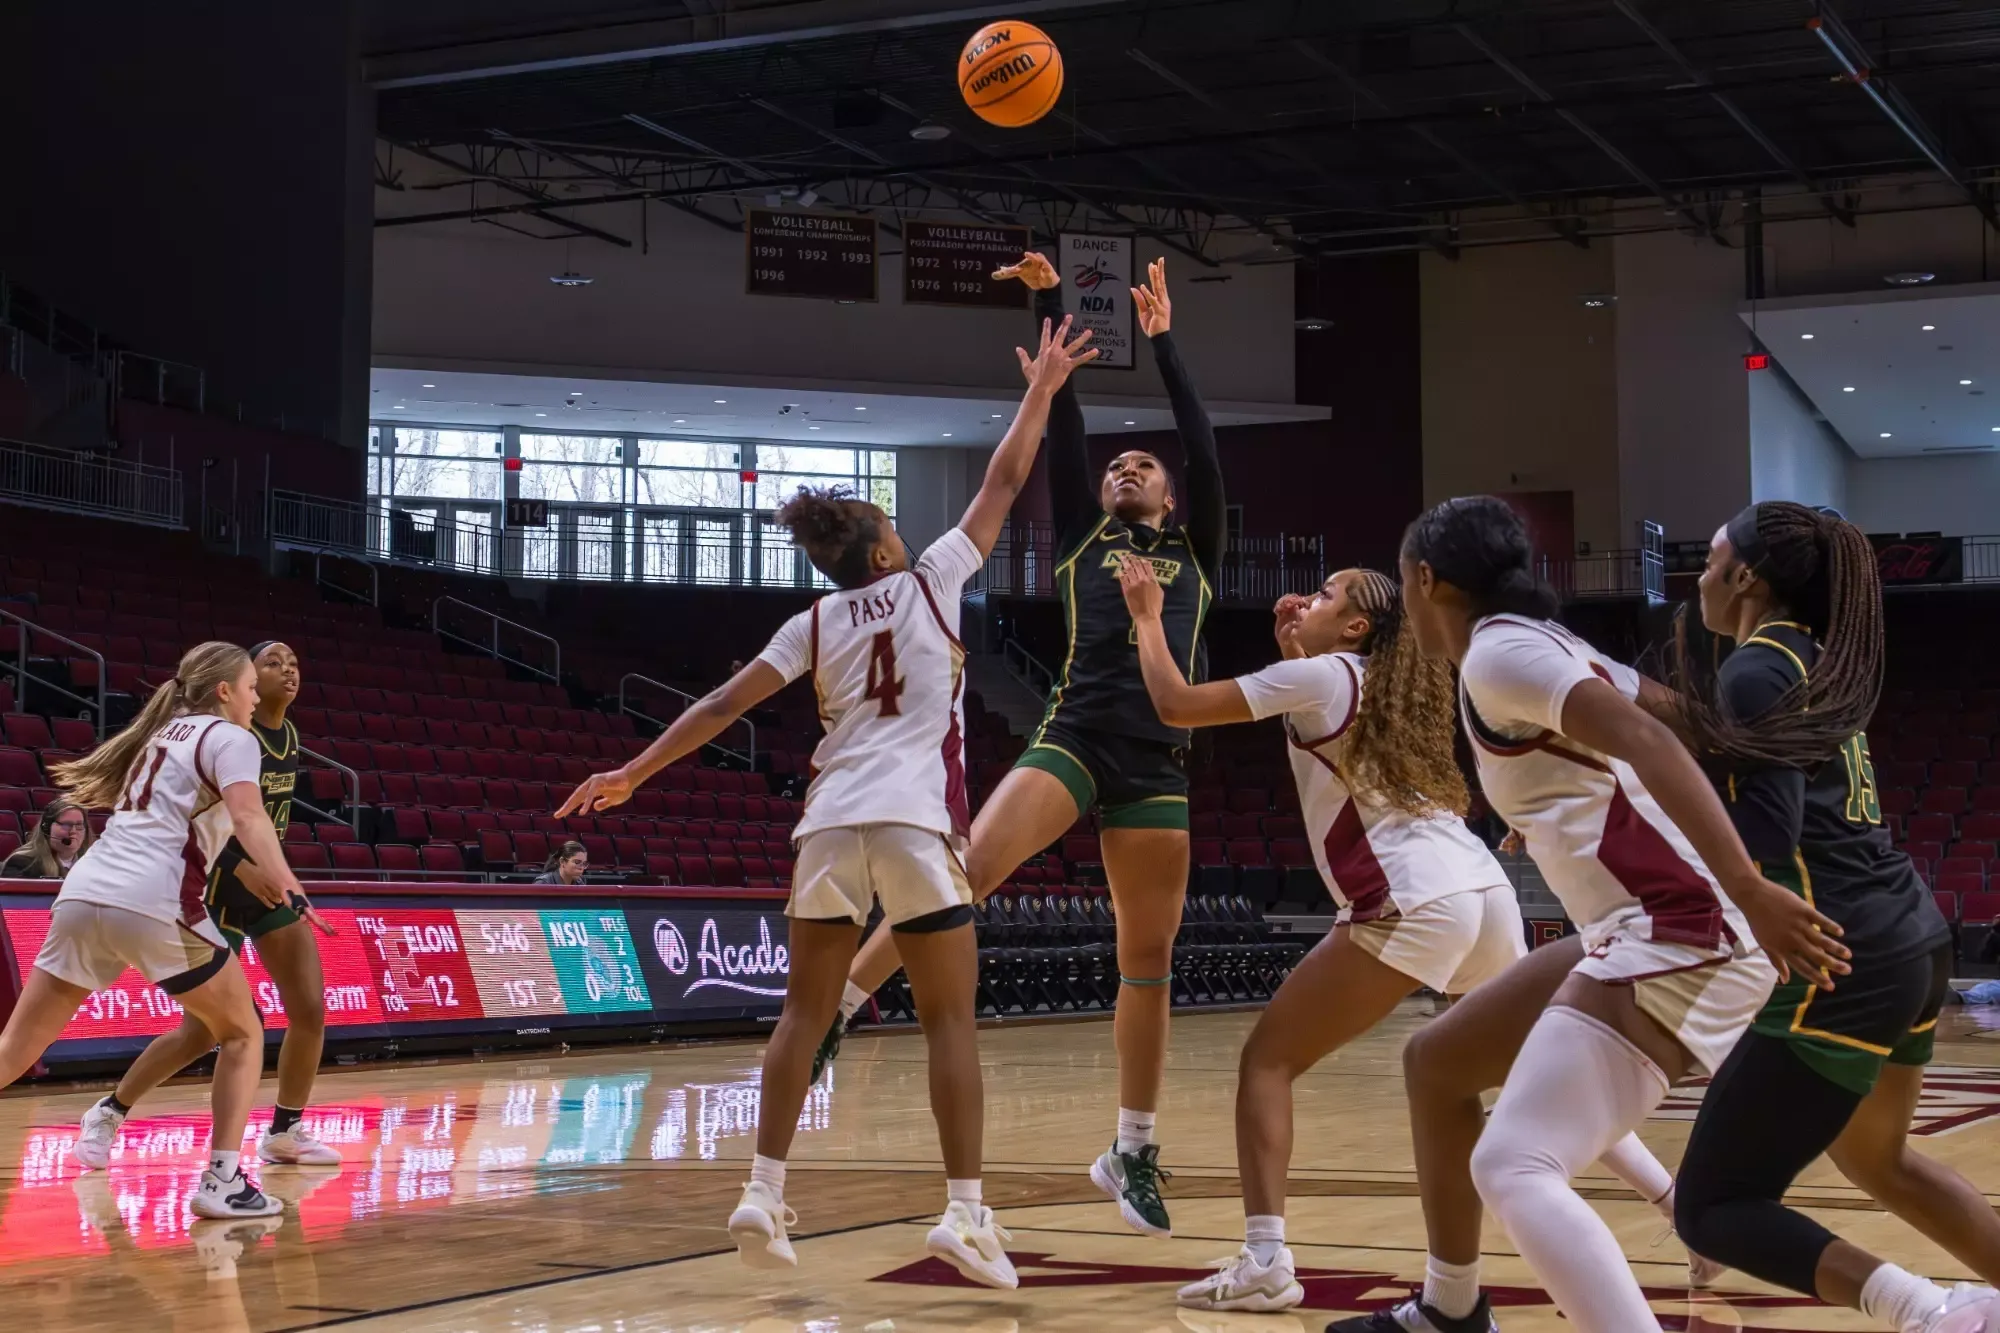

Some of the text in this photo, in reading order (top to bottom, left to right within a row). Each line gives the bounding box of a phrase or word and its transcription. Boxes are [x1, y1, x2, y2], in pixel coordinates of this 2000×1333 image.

[971, 53, 1036, 94] Wilson
[772, 215, 854, 232] VOLLEYBALL
[754, 227, 871, 242] CONFERENCE CHAMPIONSHIPS
[928, 227, 1006, 242] VOLLEYBALL
[910, 239, 1023, 253] POSTSEASON APPEARANCES
[1073, 238, 1118, 252] DANCE
[754, 246, 871, 264] 1991 1992 1993
[910, 257, 940, 268] 1972
[953, 260, 982, 271] 1973
[754, 269, 785, 281] 1996
[911, 280, 982, 293] 1976 1992
[1080, 295, 1114, 313] NDA
[511, 503, 545, 522] 114
[1289, 537, 1318, 554] 114
[848, 589, 896, 628] PASS
[864, 628, 907, 718] 4
[117, 746, 168, 811] 11
[1840, 730, 1881, 824] 15
[263, 800, 291, 840] 14
[549, 921, 589, 947] NSU
[599, 917, 624, 932] TFLS
[402, 925, 459, 953] ELON
[480, 922, 530, 954] 5:46
[614, 936, 626, 956] 2
[374, 938, 387, 960] 1
[383, 970, 396, 992] 4
[622, 964, 634, 984] 3
[424, 975, 459, 1007] 12
[503, 979, 538, 1007] 1ST
[623, 986, 646, 1002] TOL
[381, 994, 409, 1012] TOL
[516, 1027, 551, 1035] DAKTRONICS
